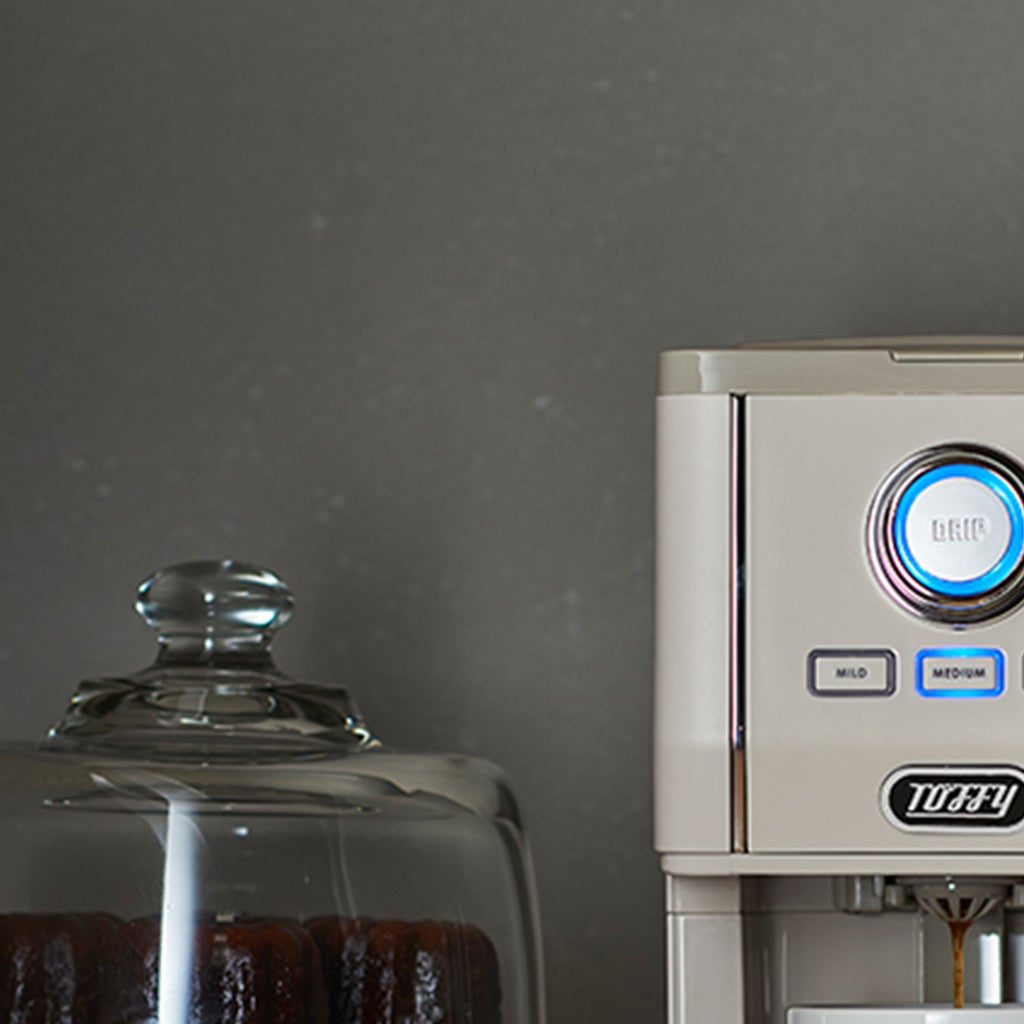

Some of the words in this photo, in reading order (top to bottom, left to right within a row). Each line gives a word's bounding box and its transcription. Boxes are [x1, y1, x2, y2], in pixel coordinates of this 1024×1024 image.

[932, 518, 986, 542] DRIP
[835, 667, 868, 679] MILD
[932, 667, 987, 679] MEDIUM
